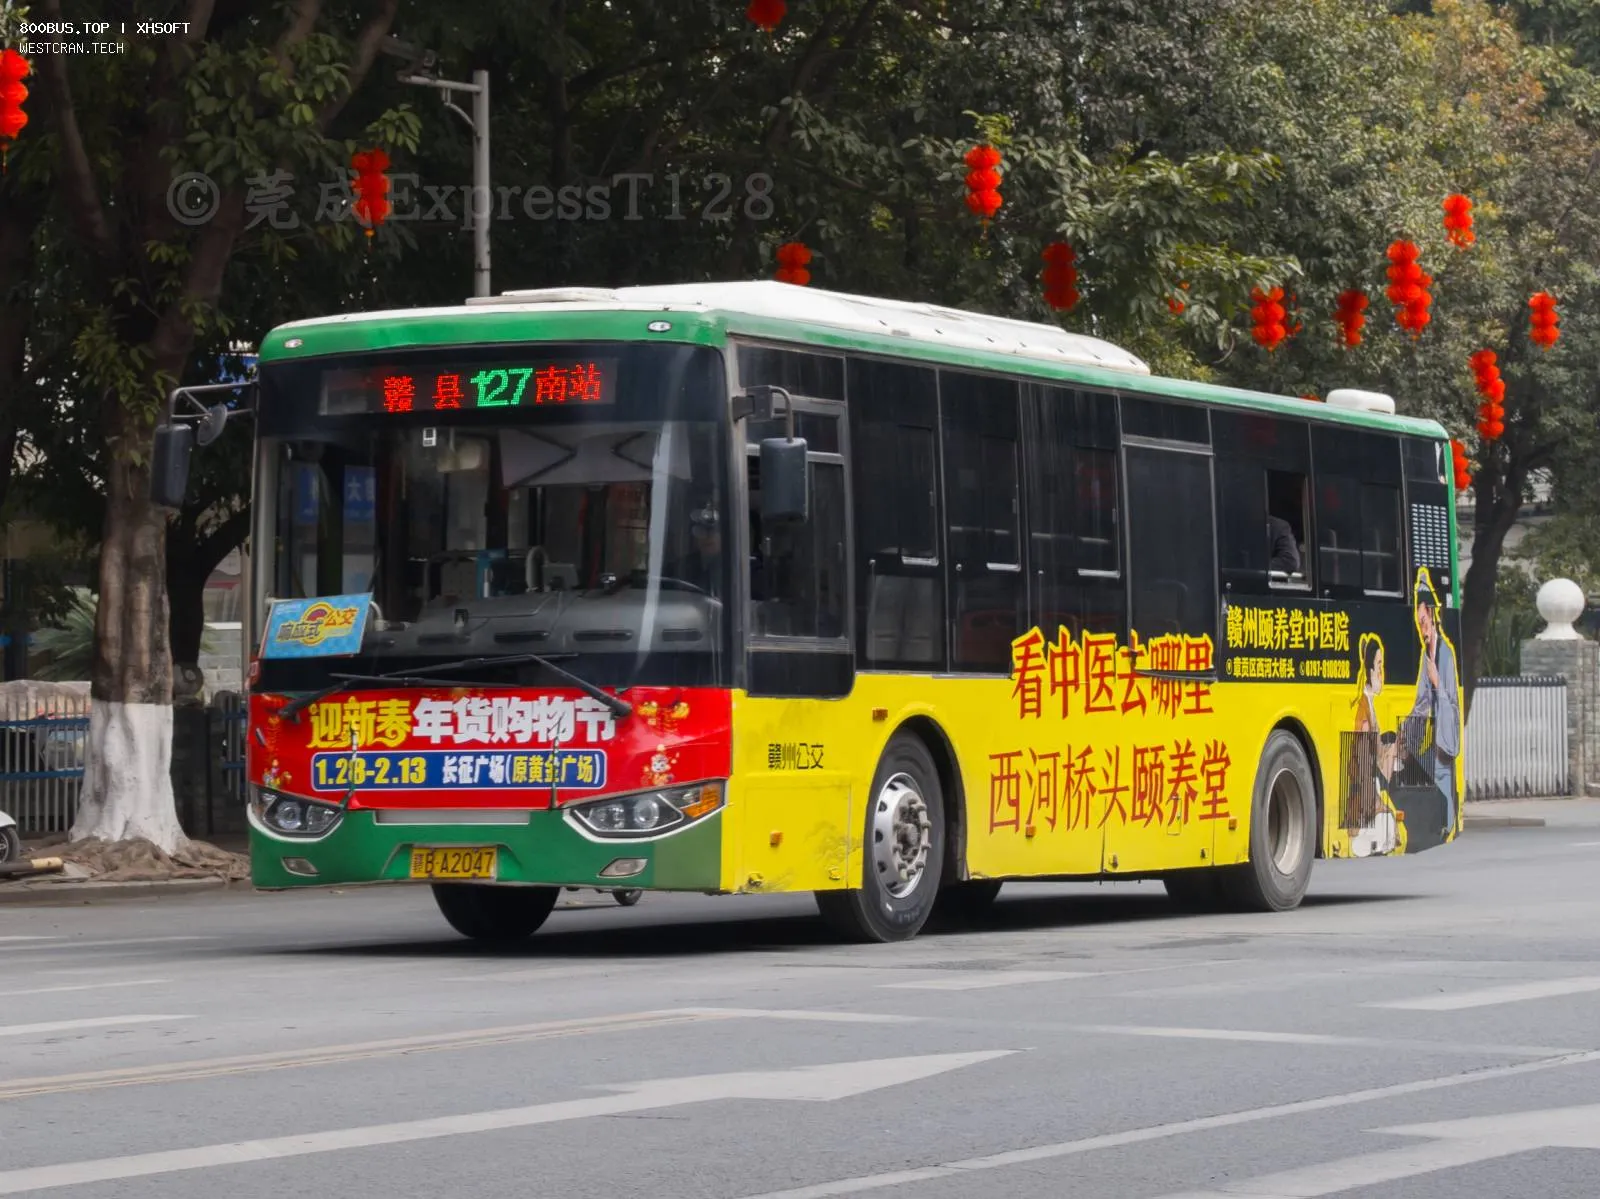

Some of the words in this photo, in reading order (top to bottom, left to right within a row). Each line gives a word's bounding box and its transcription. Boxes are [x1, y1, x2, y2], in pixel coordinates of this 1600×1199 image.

[470, 368, 533, 407] 127
[535, 362, 601, 403] 南站
[324, 607, 358, 627] 公交
[1227, 605, 1350, 652] 赣州颐养堂中医院
[1012, 625, 1214, 720] 看中医去哪里
[315, 757, 427, 785] 1.28-2.13
[768, 742, 824, 770] 赣州公交
[988, 739, 1231, 835] 西河桥头颐养堂
